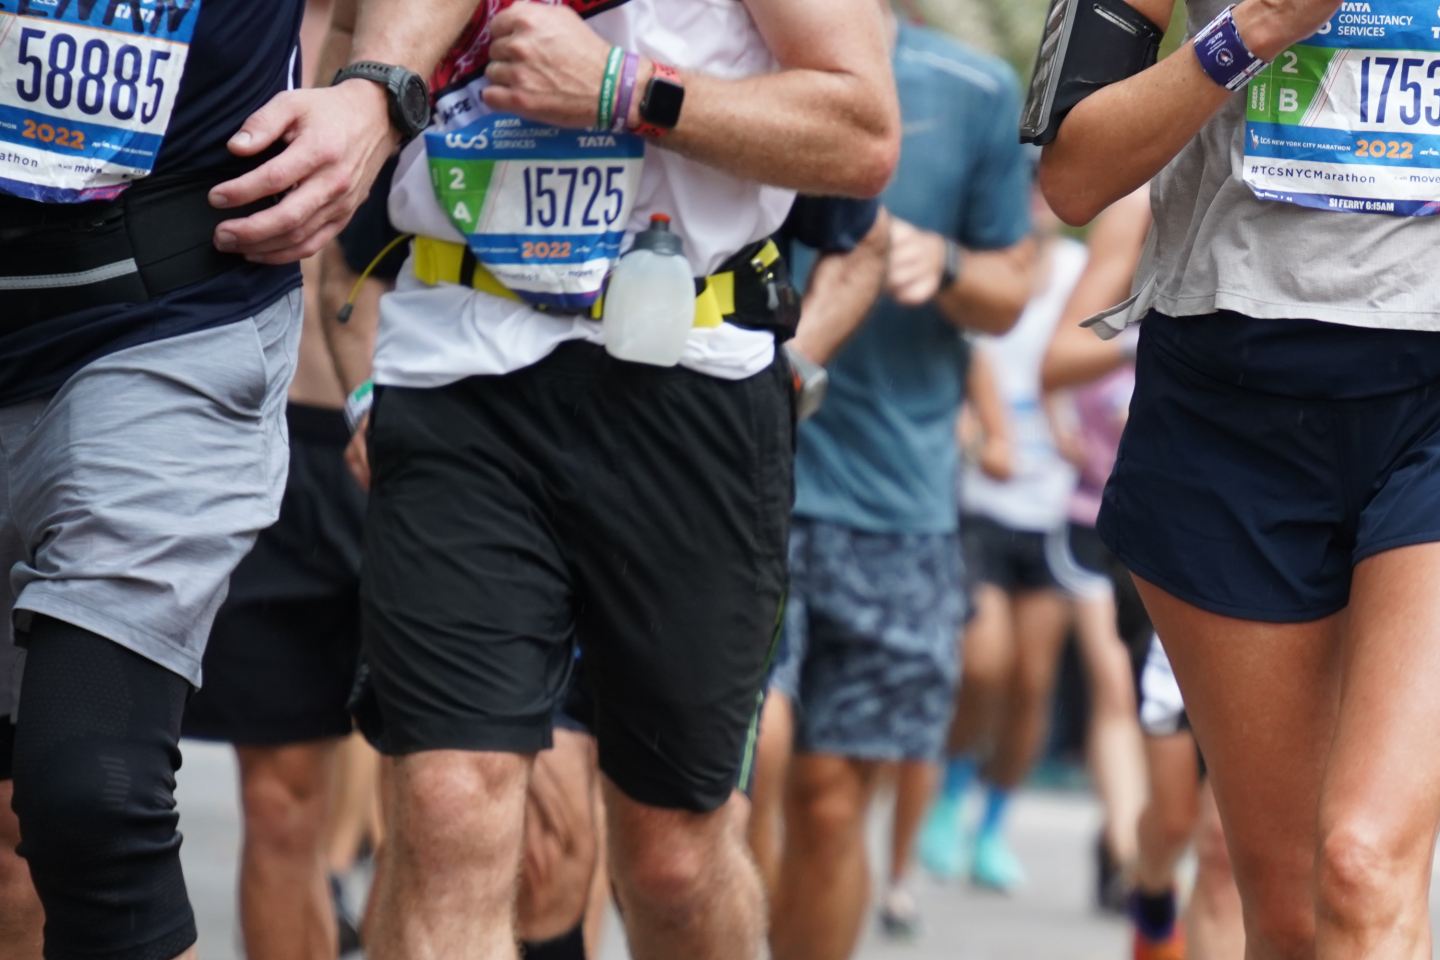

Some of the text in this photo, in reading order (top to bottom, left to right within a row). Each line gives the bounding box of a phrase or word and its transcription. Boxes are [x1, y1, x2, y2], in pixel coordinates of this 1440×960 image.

[1340, 2, 1371, 13] TATA
[1338, 14, 1413, 26] CONSULTANCY
[1337, 26, 1385, 37] SERVICES
[1281, 50, 1298, 74] 2
[16, 26, 171, 124] 58885
[1279, 88, 1298, 112] B
[494, 118, 521, 128] TATA
[22, 119, 85, 150] 2022
[577, 136, 616, 148] TATA
[492, 139, 536, 149] SERVICES
[1317, 143, 1351, 151] MARATHON
[1355, 140, 1413, 159] 2022
[449, 167, 465, 190] 2
[1251, 165, 1376, 183] #TCSNYCMarathon
[523, 166, 624, 227] 15725
[1338, 198, 1364, 210] FERRY
[522, 241, 571, 258] 2022
